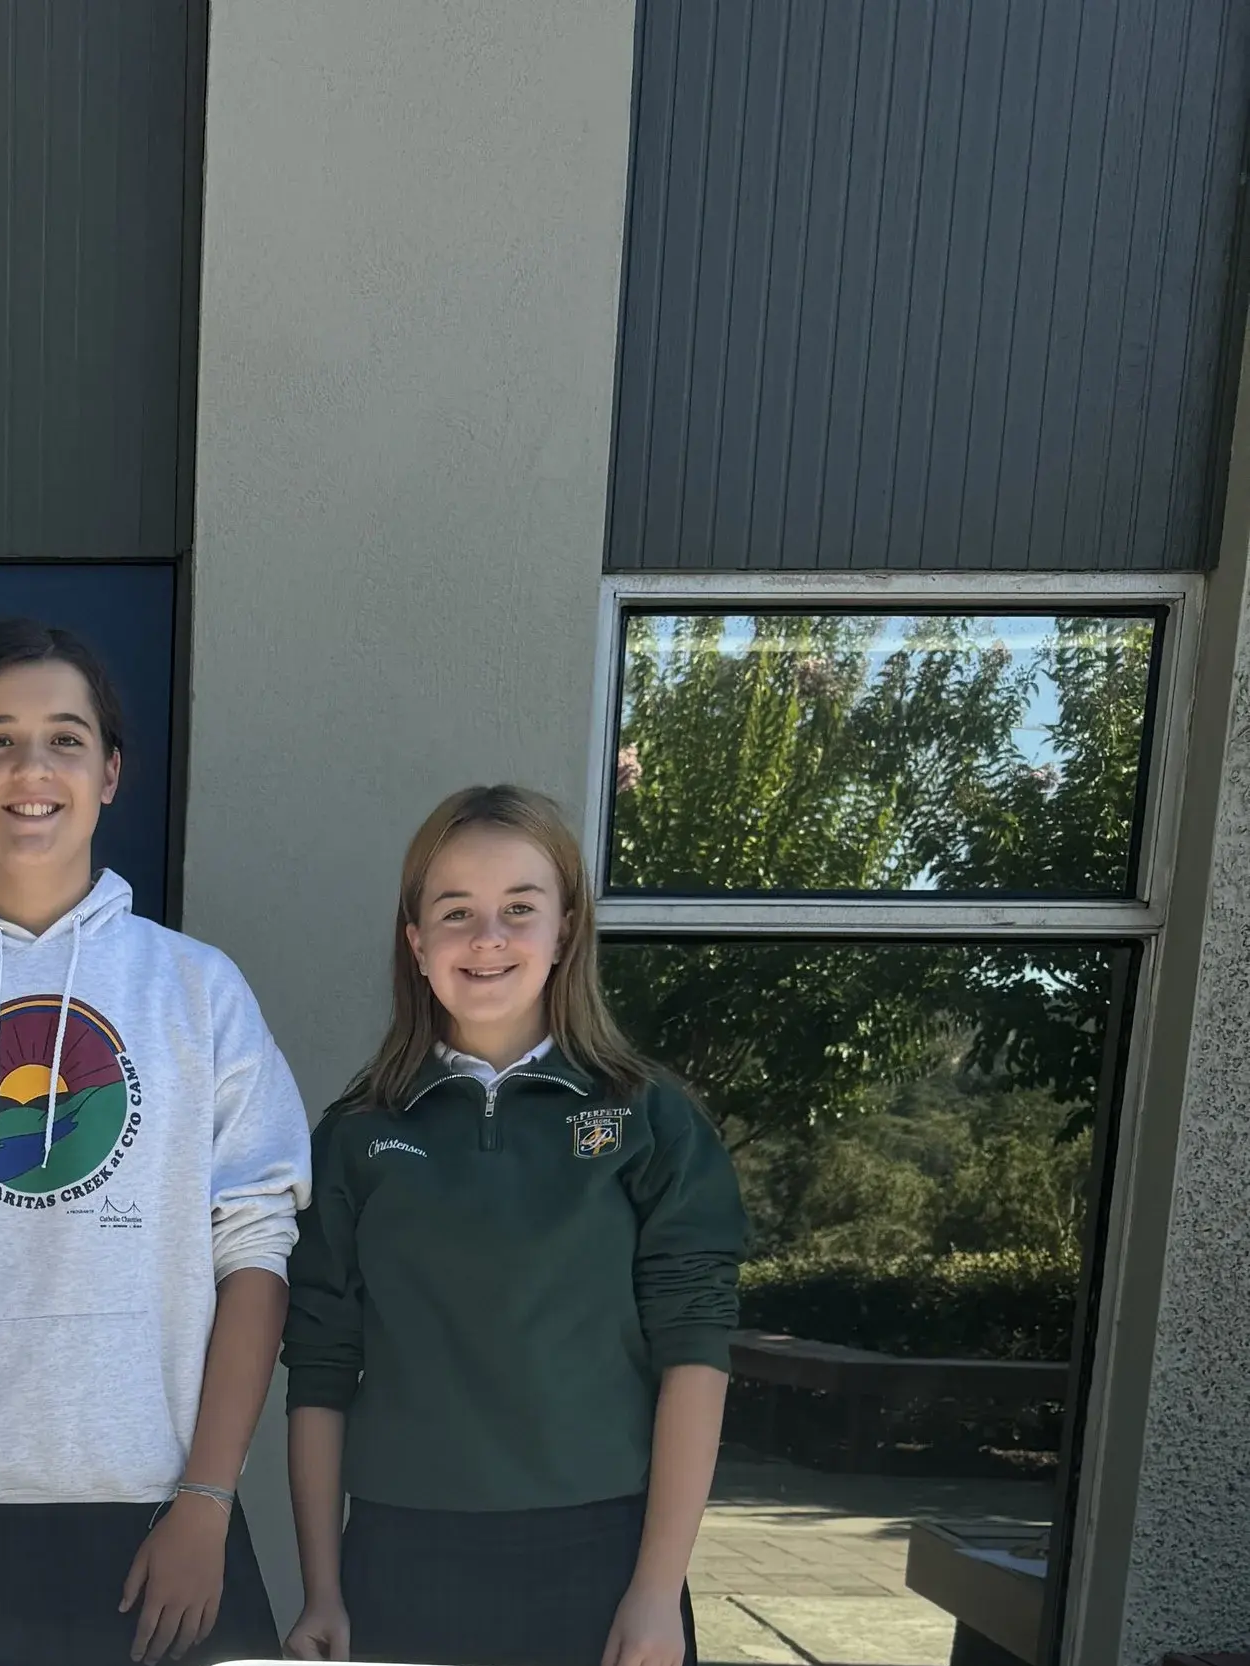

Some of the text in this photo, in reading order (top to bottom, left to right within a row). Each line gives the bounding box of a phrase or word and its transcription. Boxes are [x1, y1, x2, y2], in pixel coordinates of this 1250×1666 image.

[120, 1055, 142, 1107] CAMP
[121, 1112, 142, 1148] CYO
[110, 1149, 124, 1168] at
[60, 1165, 114, 1203] CREEK
